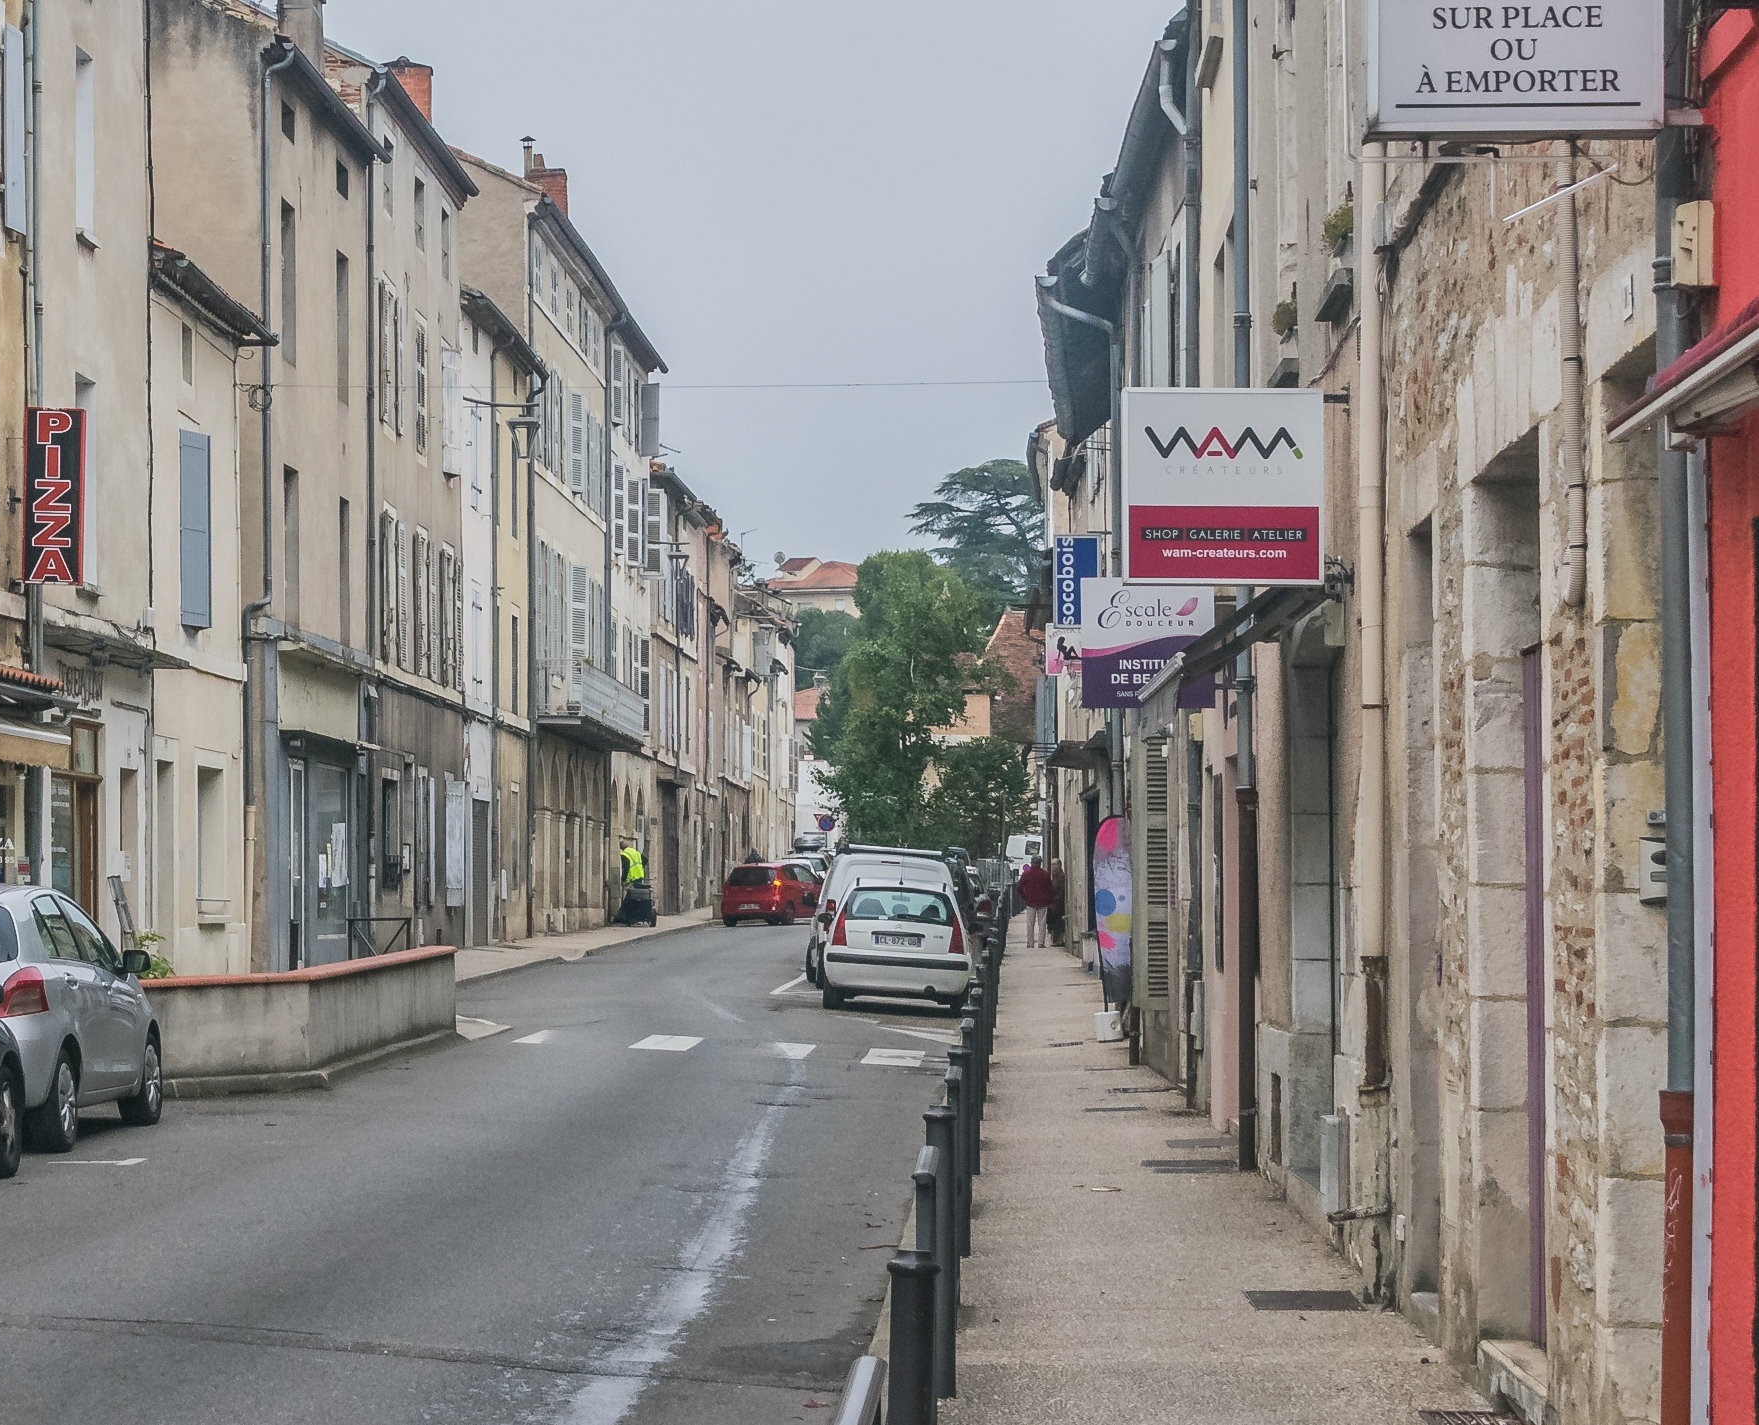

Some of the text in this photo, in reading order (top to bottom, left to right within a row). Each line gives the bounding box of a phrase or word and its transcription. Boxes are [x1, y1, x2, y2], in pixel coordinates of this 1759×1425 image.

[1432, 5, 1603, 30] SUR PLACE
[1490, 38, 1537, 61] OU
[1415, 64, 1620, 93] À EMPORTER
[1144, 426, 1303, 459] WAM
[1165, 464, 1283, 475] CRÉATEURS
[29, 410, 73, 582] PIZZA
[1145, 529, 1303, 540] SHOP GALERIE ATELIER
[1162, 548, 1287, 558] wam-createurs.com
[1057, 537, 1075, 626] socobois
[1097, 589, 1172, 629] Escale
[1119, 659, 1170, 670] INSTITU
[1111, 673, 1129, 684] DE
[4, 856, 14, 864] 95
